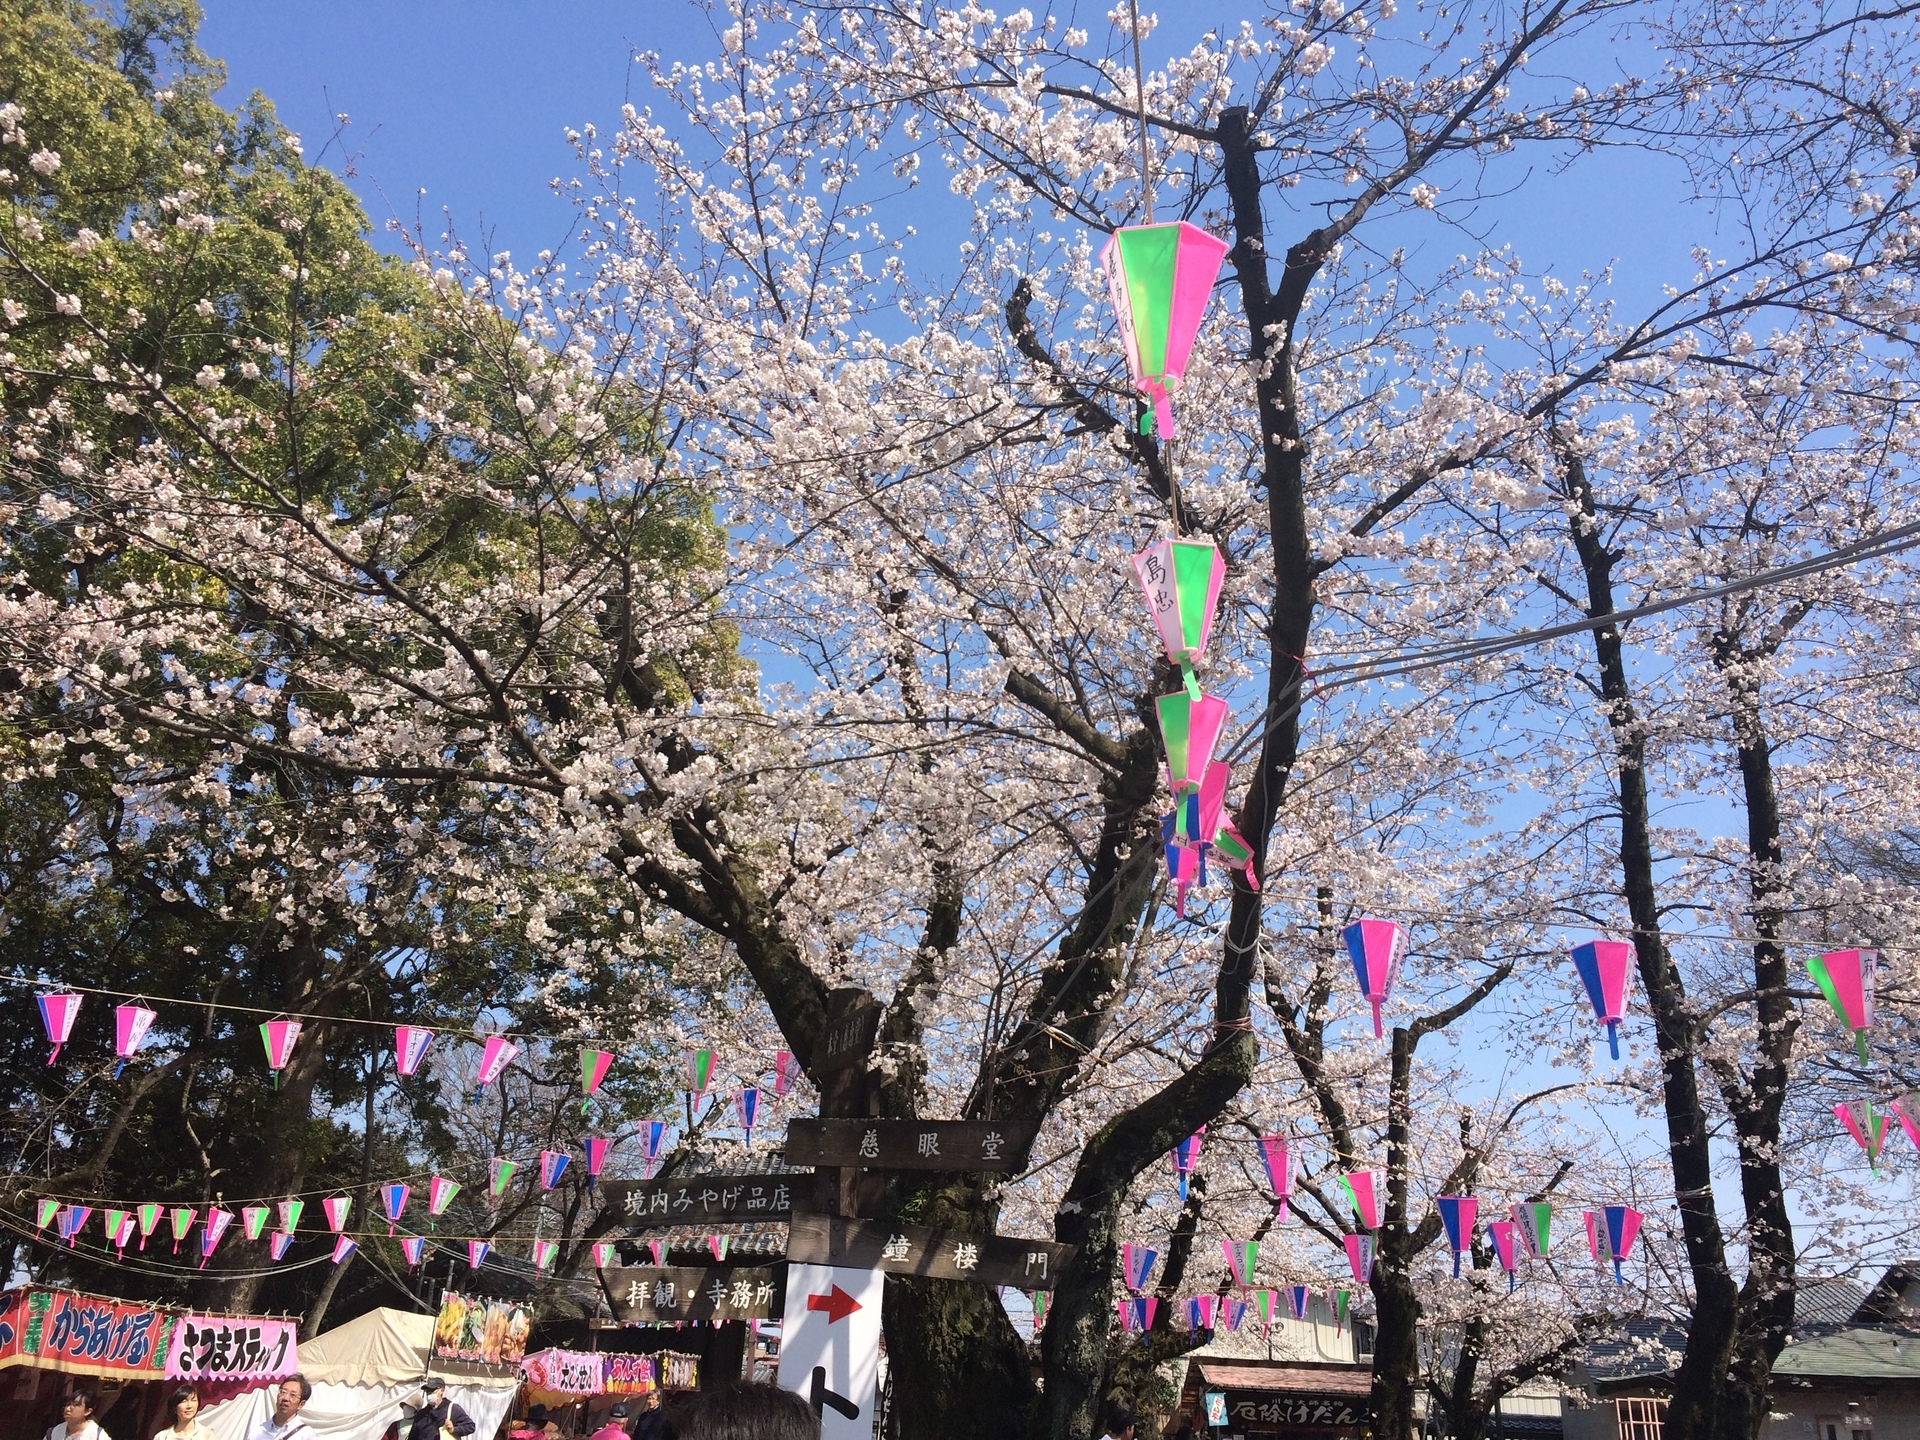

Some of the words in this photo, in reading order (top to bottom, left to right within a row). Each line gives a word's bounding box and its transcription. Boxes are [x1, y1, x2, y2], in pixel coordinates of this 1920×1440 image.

[1148, 554, 1174, 615] 島忠
[859, 1128, 1005, 1161] 慈眼堂
[623, 1184, 791, 1217] 境内みやげ品店
[881, 1233, 1049, 1281] 鐘楼門
[626, 1278, 778, 1311] 拝観・寺務所
[49, 1297, 156, 1366] からあげ屋
[180, 1312, 290, 1373] さつまスティック
[560, 1362, 593, 1390] えびせん
